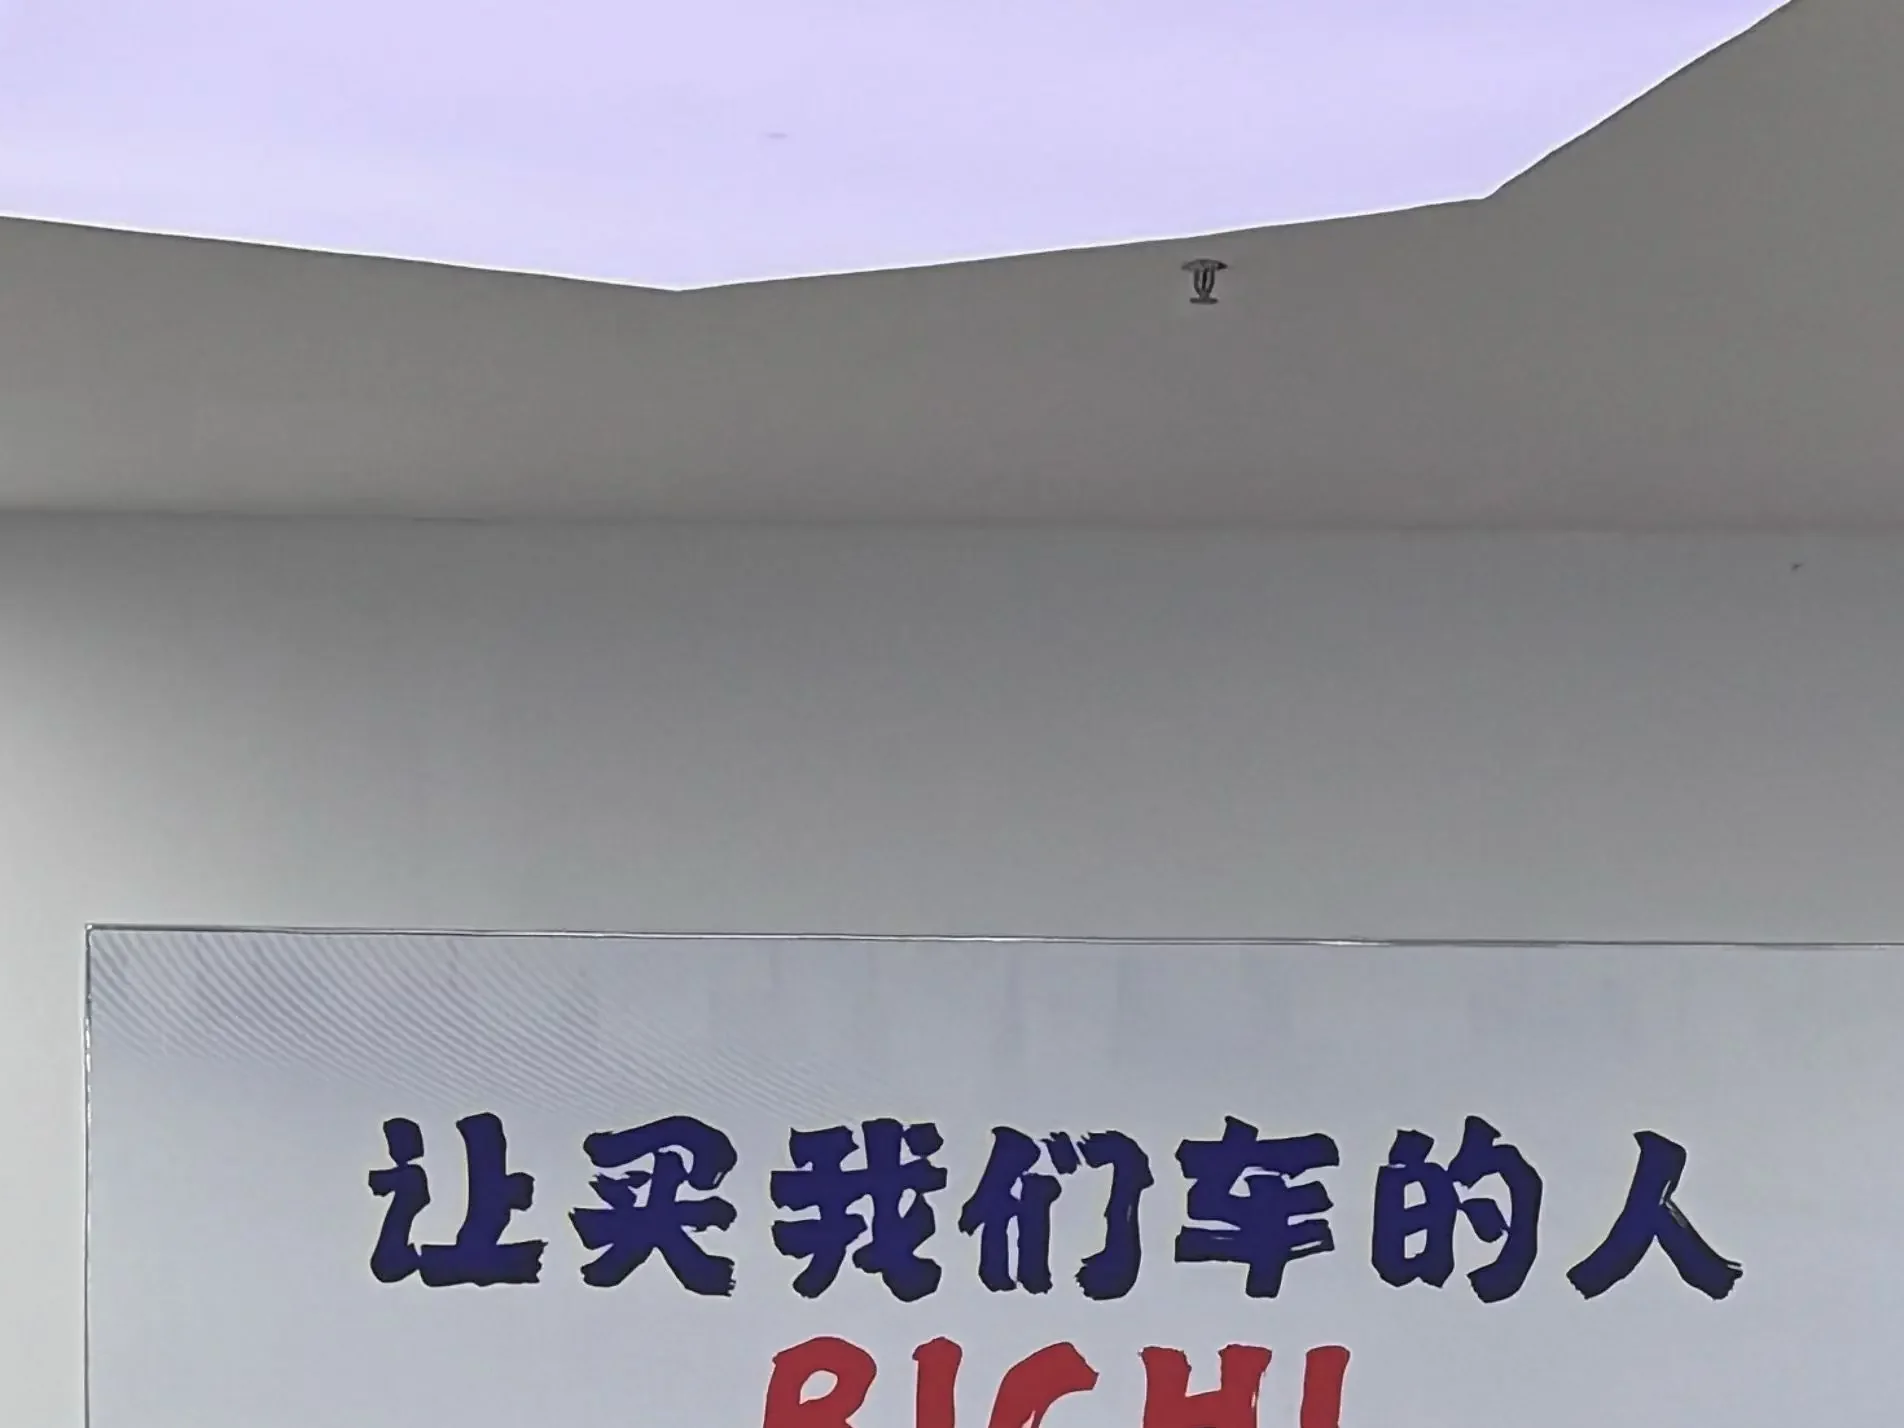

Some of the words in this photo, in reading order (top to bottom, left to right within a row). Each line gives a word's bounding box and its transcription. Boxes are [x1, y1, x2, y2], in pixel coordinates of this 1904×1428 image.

[367, 1111, 1745, 1305] 让买我们车的人
